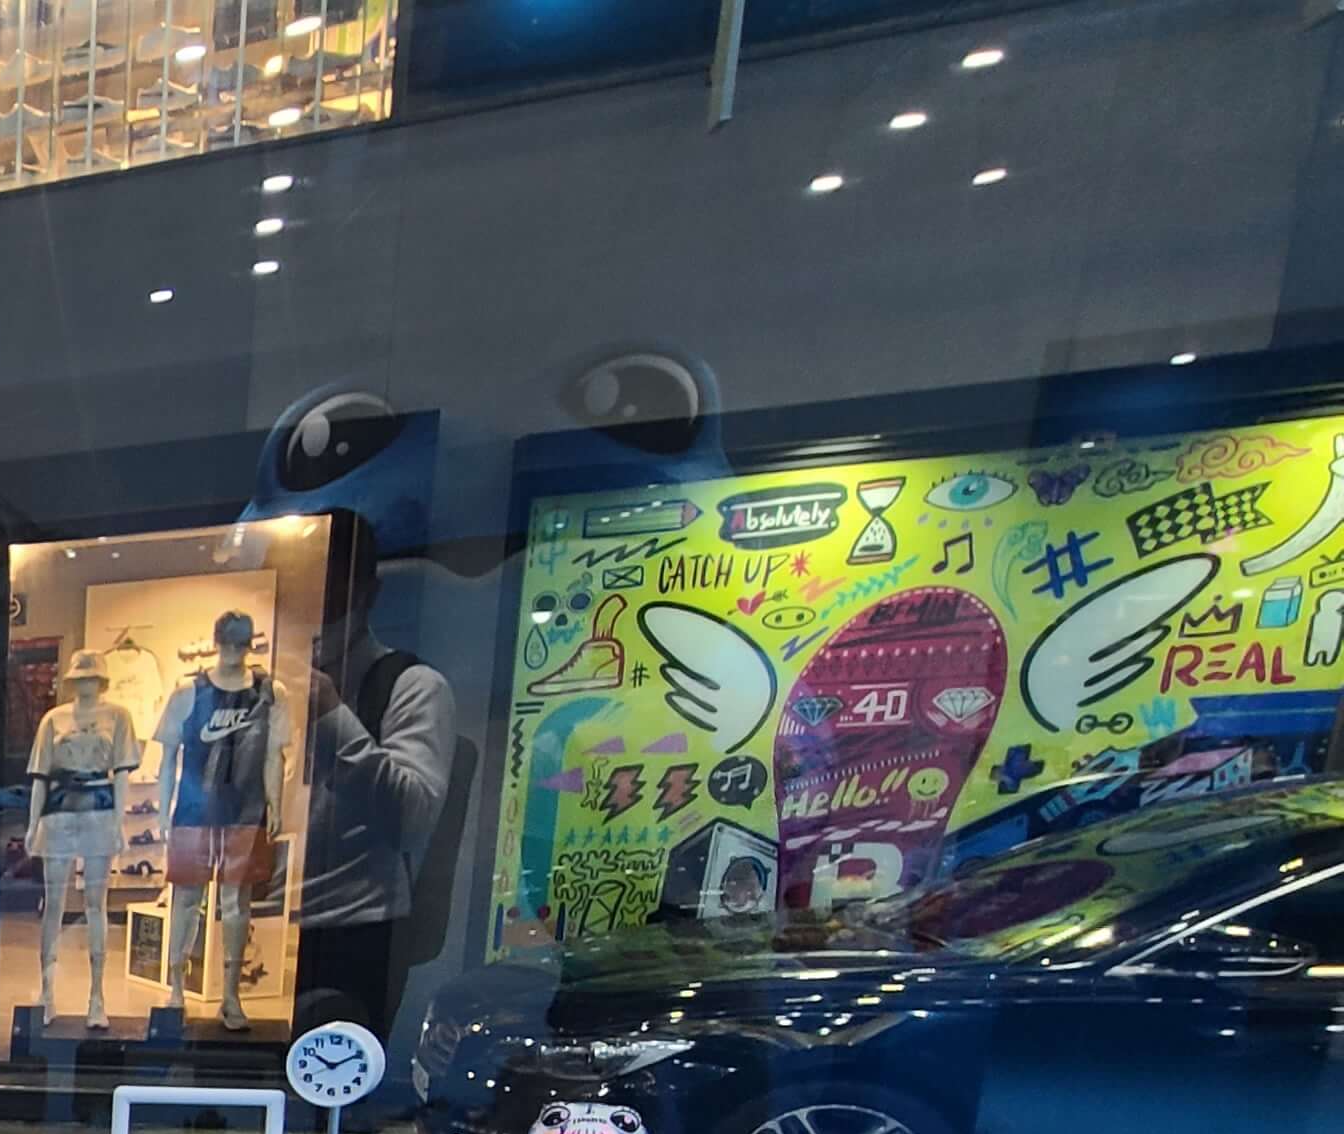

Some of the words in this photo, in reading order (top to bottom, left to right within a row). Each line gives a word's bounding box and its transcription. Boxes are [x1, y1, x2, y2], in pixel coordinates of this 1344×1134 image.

[658, 559, 734, 594] CATCH
[743, 553, 790, 585] UP
[1160, 641, 1296, 694] REAL
[210, 708, 249, 729] NIKE
[314, 1038, 325, 1049] 11
[329, 1034, 344, 1046] 12
[302, 1047, 316, 1057] 10
